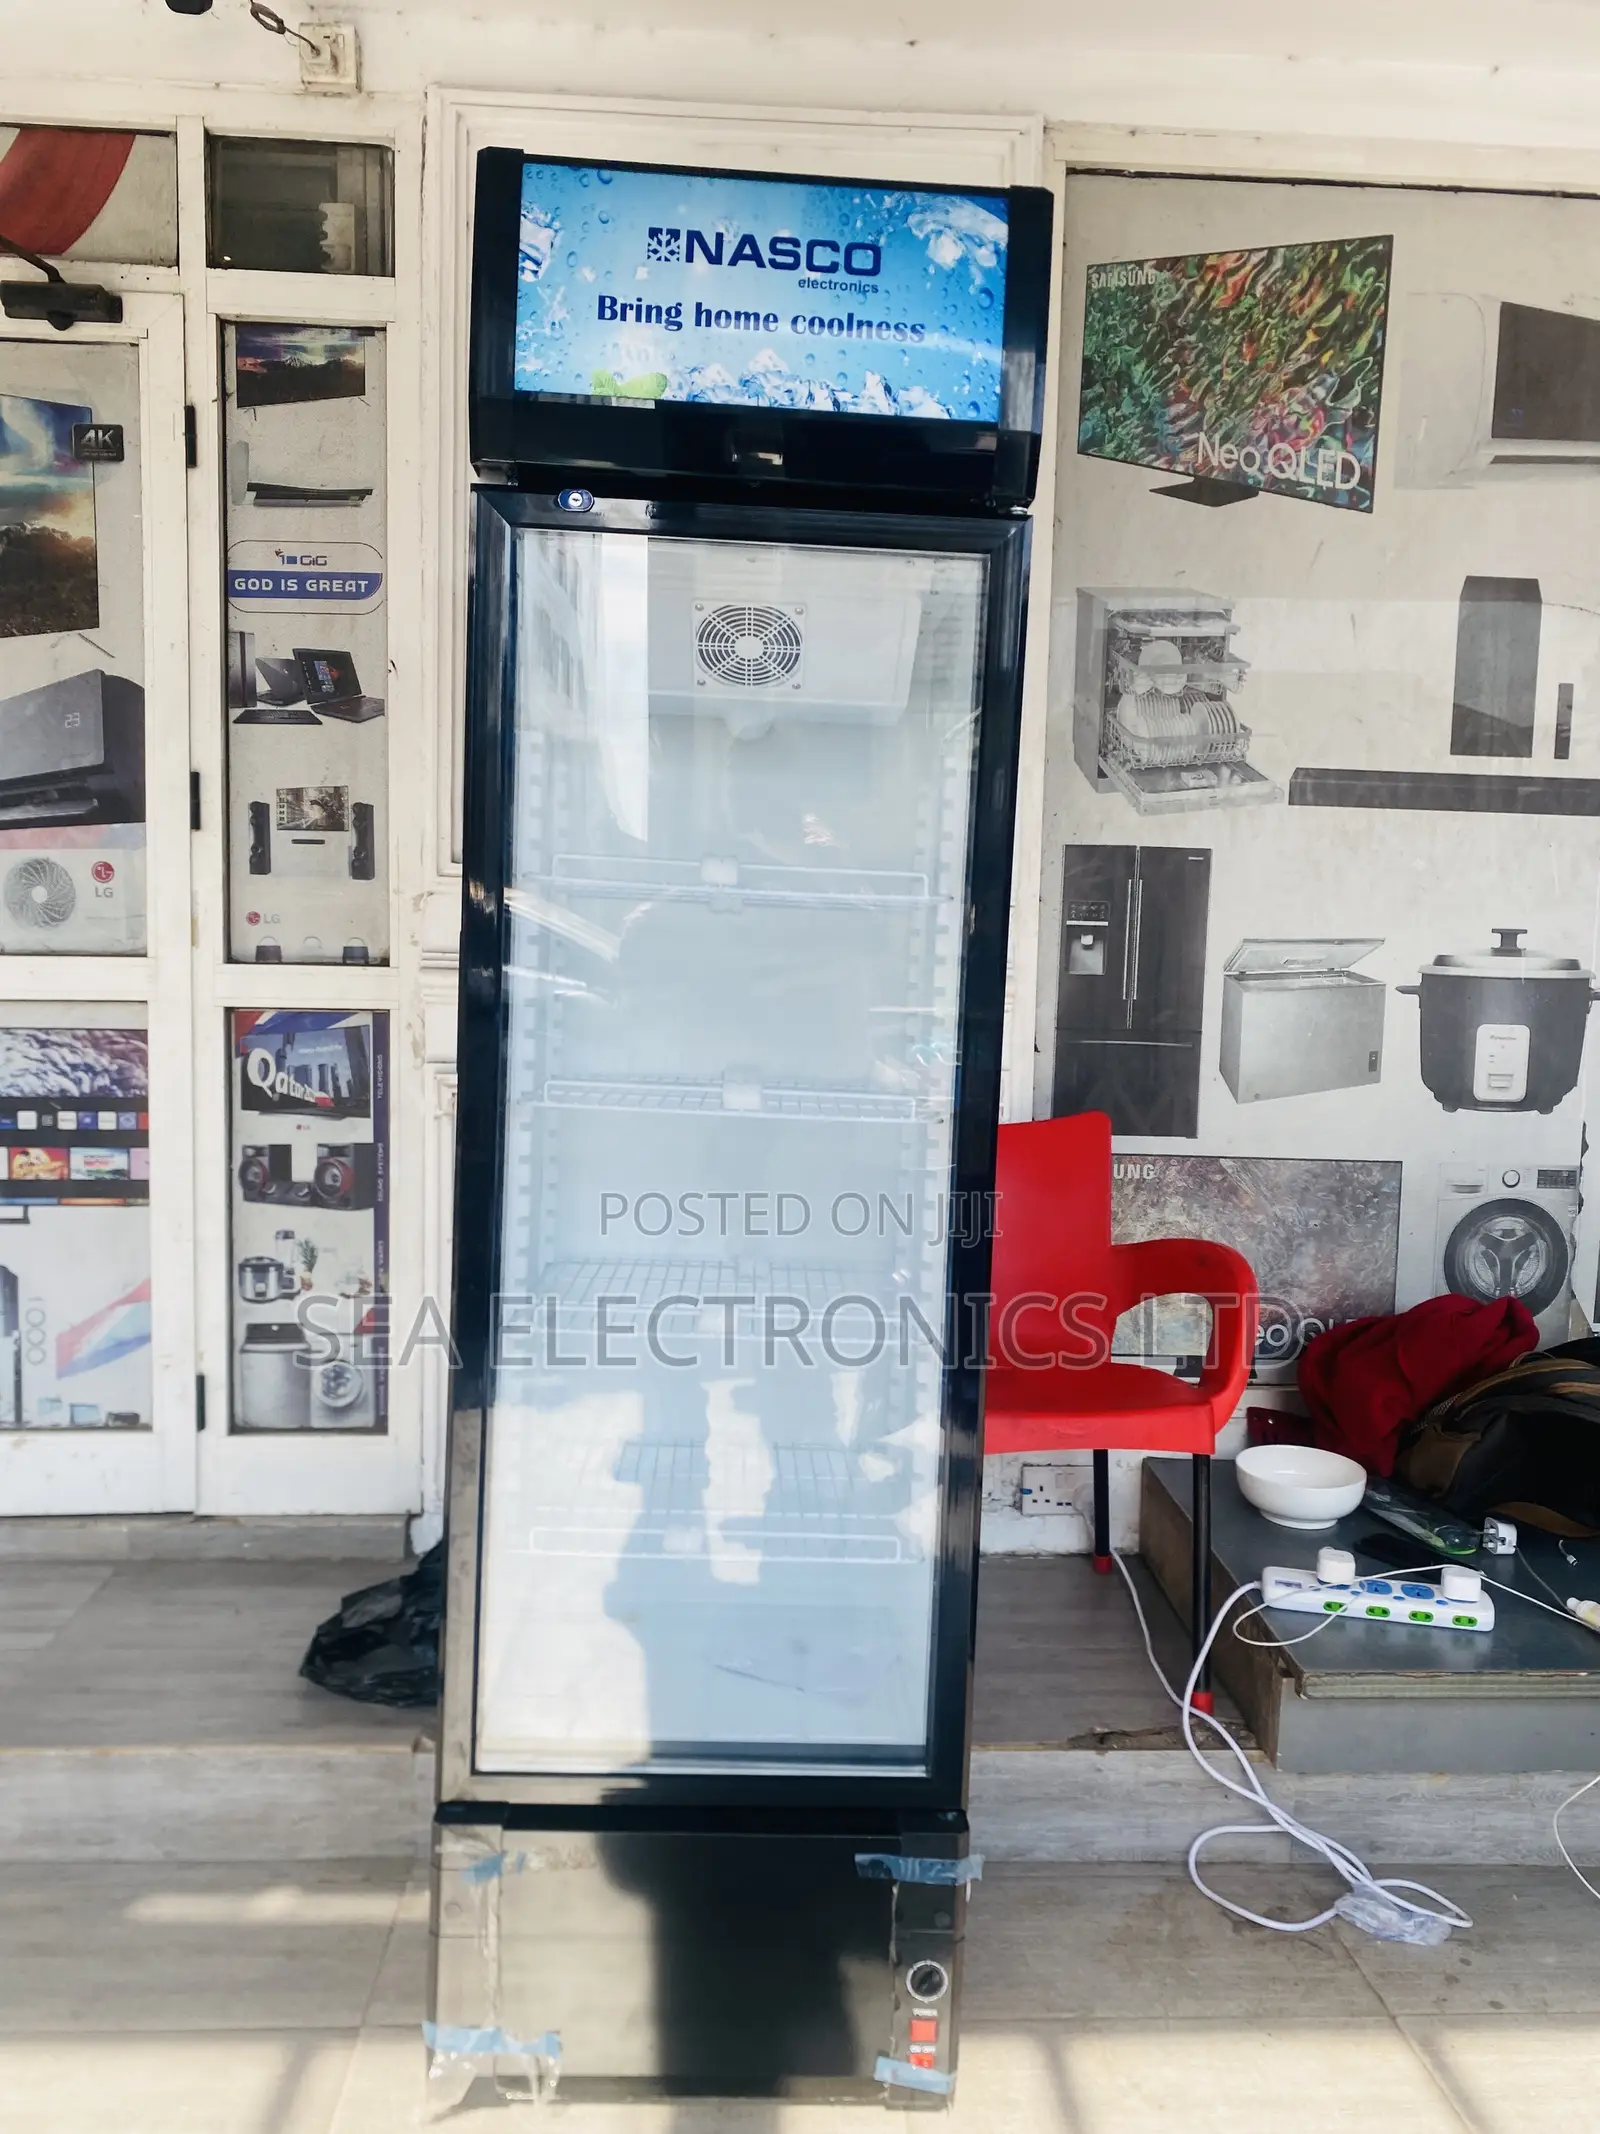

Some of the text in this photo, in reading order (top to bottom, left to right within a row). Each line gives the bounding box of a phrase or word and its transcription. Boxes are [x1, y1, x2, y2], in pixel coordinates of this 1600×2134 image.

[685, 228, 882, 277] NASCO
[798, 276, 879, 295] electronics
[597, 294, 926, 344] Bring home coolness
[81, 429, 114, 449] 4K
[1198, 431, 1361, 490] Neo QLED
[234, 577, 369, 594] GOD IS GREAT
[94, 886, 114, 899] LG
[263, 913, 281, 925] LG
[1113, 1163, 1156, 1180] UNG
